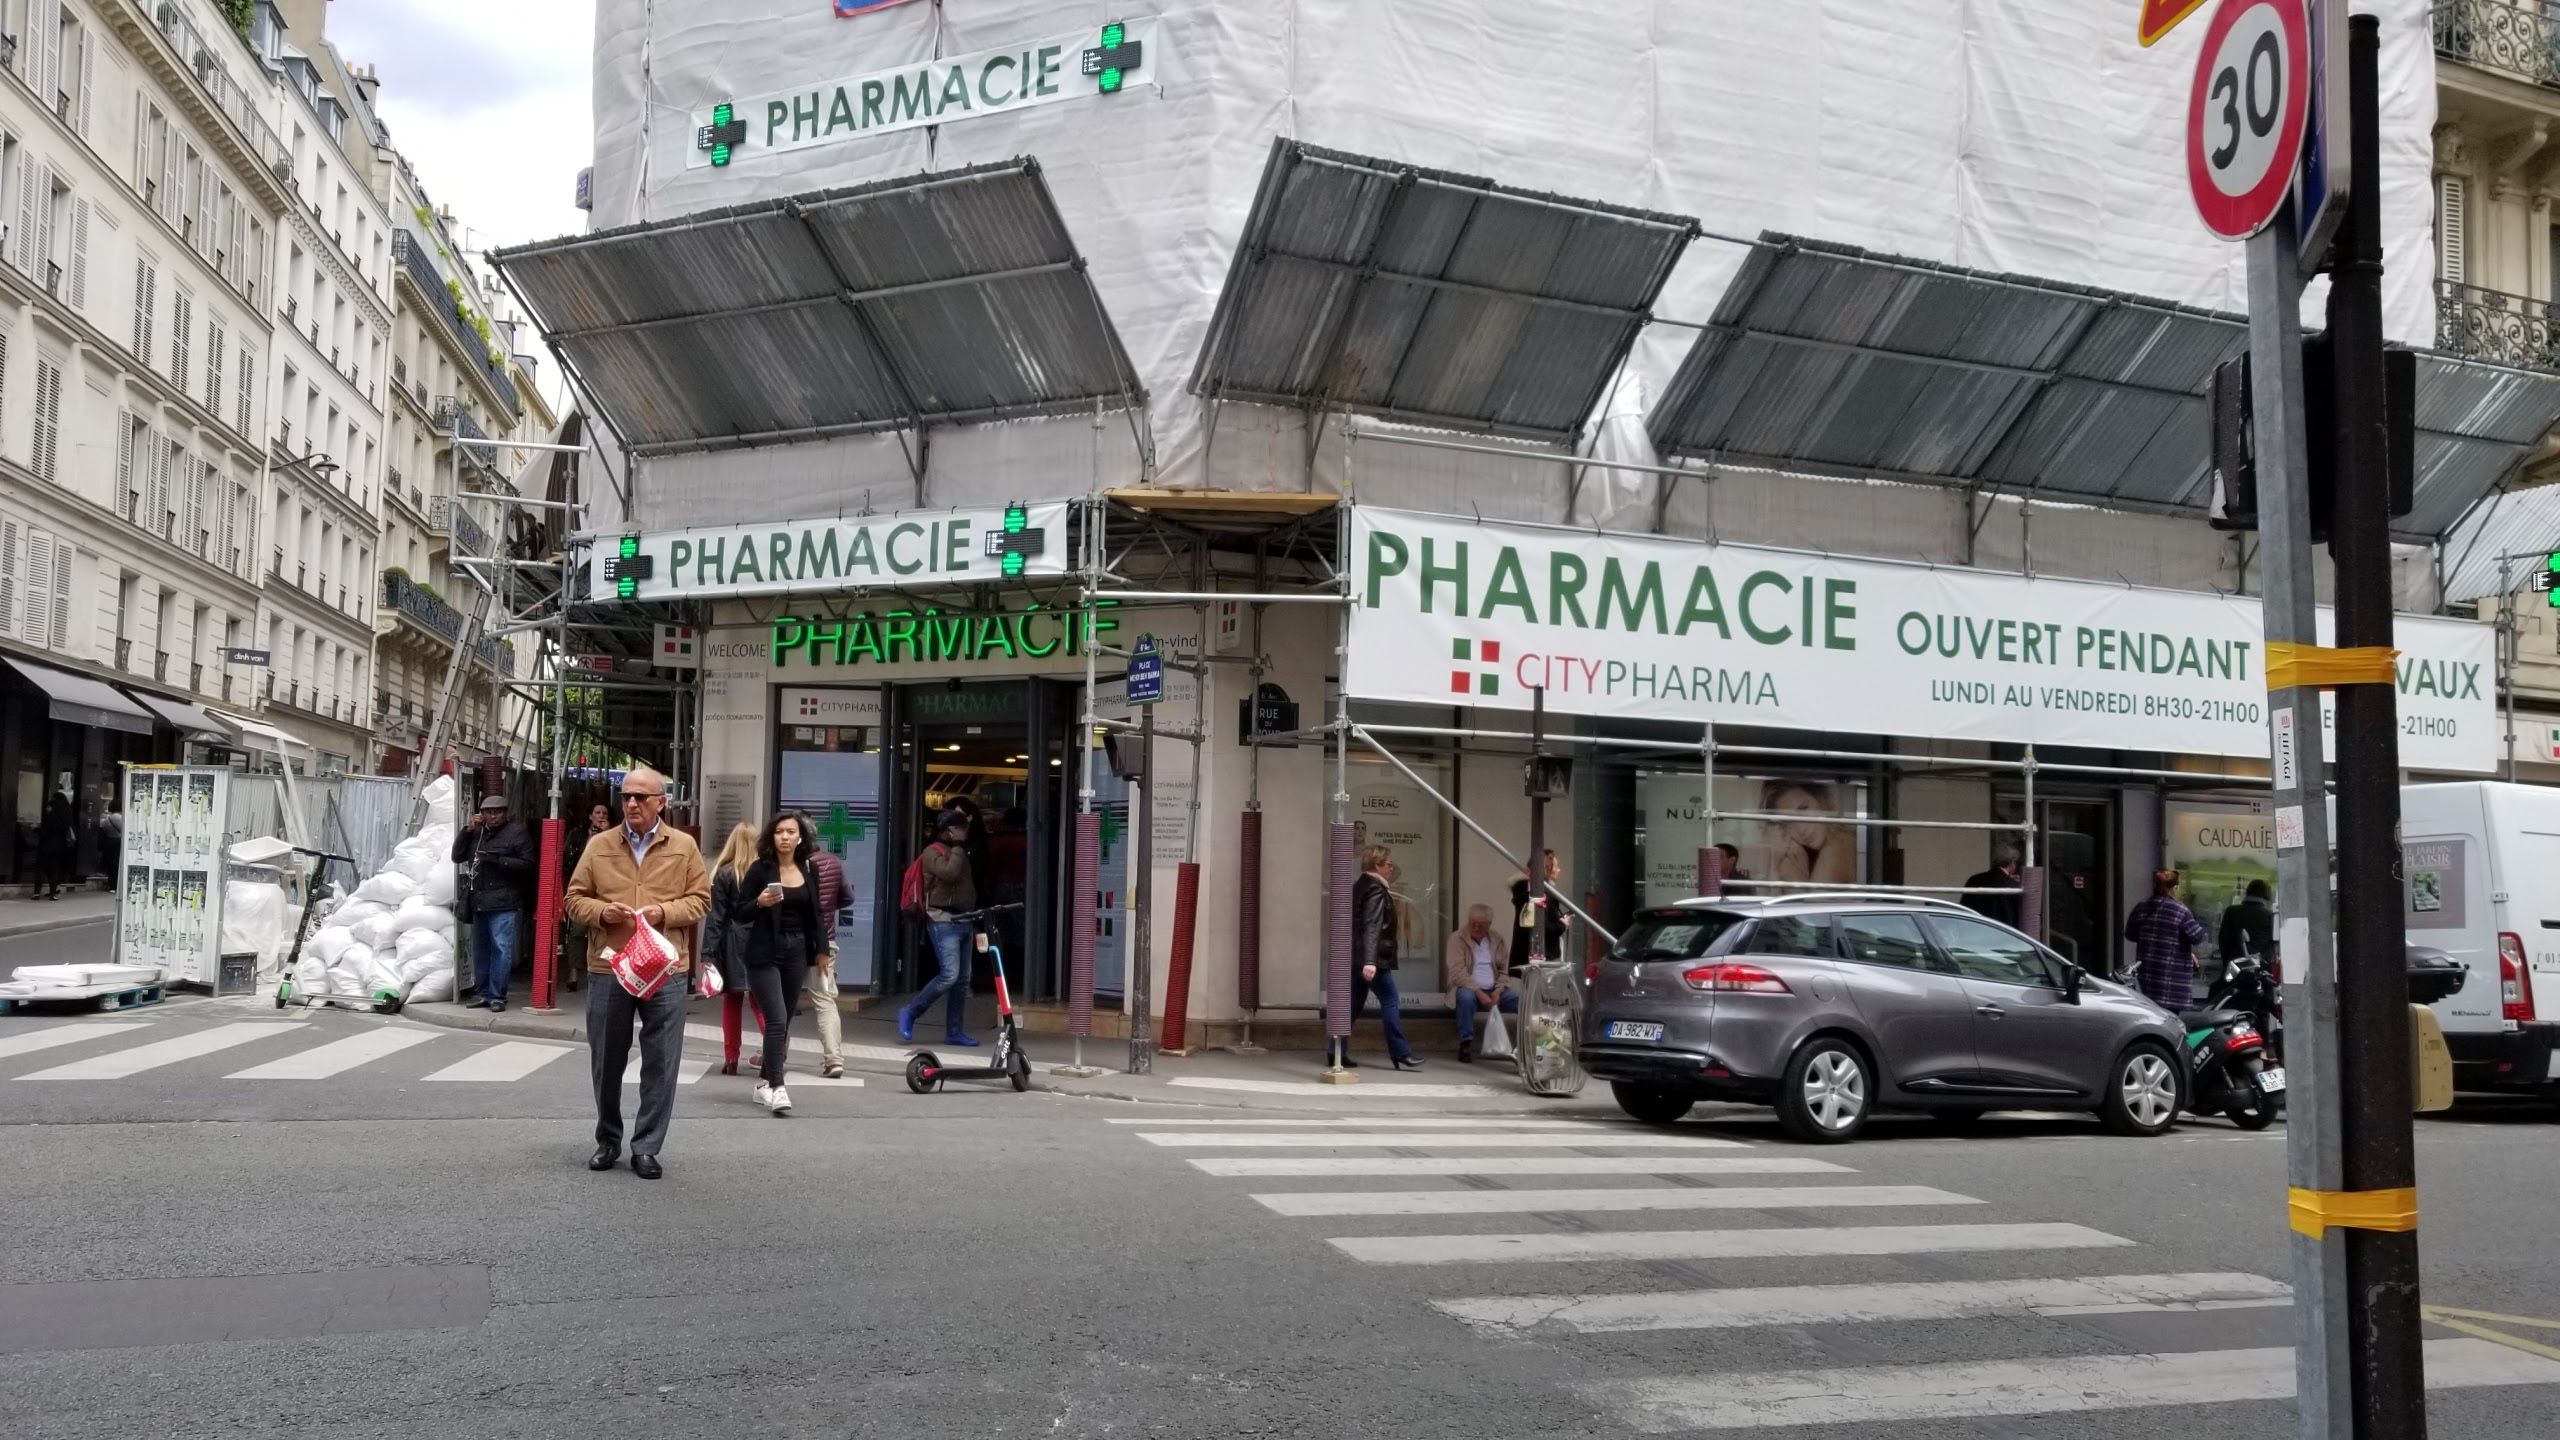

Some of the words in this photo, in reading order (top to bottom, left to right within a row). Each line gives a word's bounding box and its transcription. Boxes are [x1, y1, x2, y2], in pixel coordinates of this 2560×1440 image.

[766, 45, 1062, 147] PHARMACIE
[2210, 29, 2281, 171] 30
[670, 518, 972, 588] PHARMACIE
[1366, 530, 1857, 651] PHARMACIE
[233, 652, 250, 661] dinh
[708, 644, 766, 658] WELCOME
[772, 599, 1123, 667] PHARMACIE
[1897, 611, 2061, 667] OUVERT
[2076, 626, 2251, 682] PENDANT
[2397, 658, 2482, 701] VAUX
[1516, 653, 1780, 708] CITYPHARMA
[1931, 680, 1996, 705] LUNDI
[2003, 685, 2033, 707] AU
[2040, 687, 2138, 715] VENDREDI
[2144, 696, 2260, 724] 8H30-21H00
[820, 702, 882, 713] CITYPHARM
[1259, 708, 1279, 719] RUE
[1361, 798, 1400, 809] LIERAC
[1001, 1039, 1010, 1059] dott
